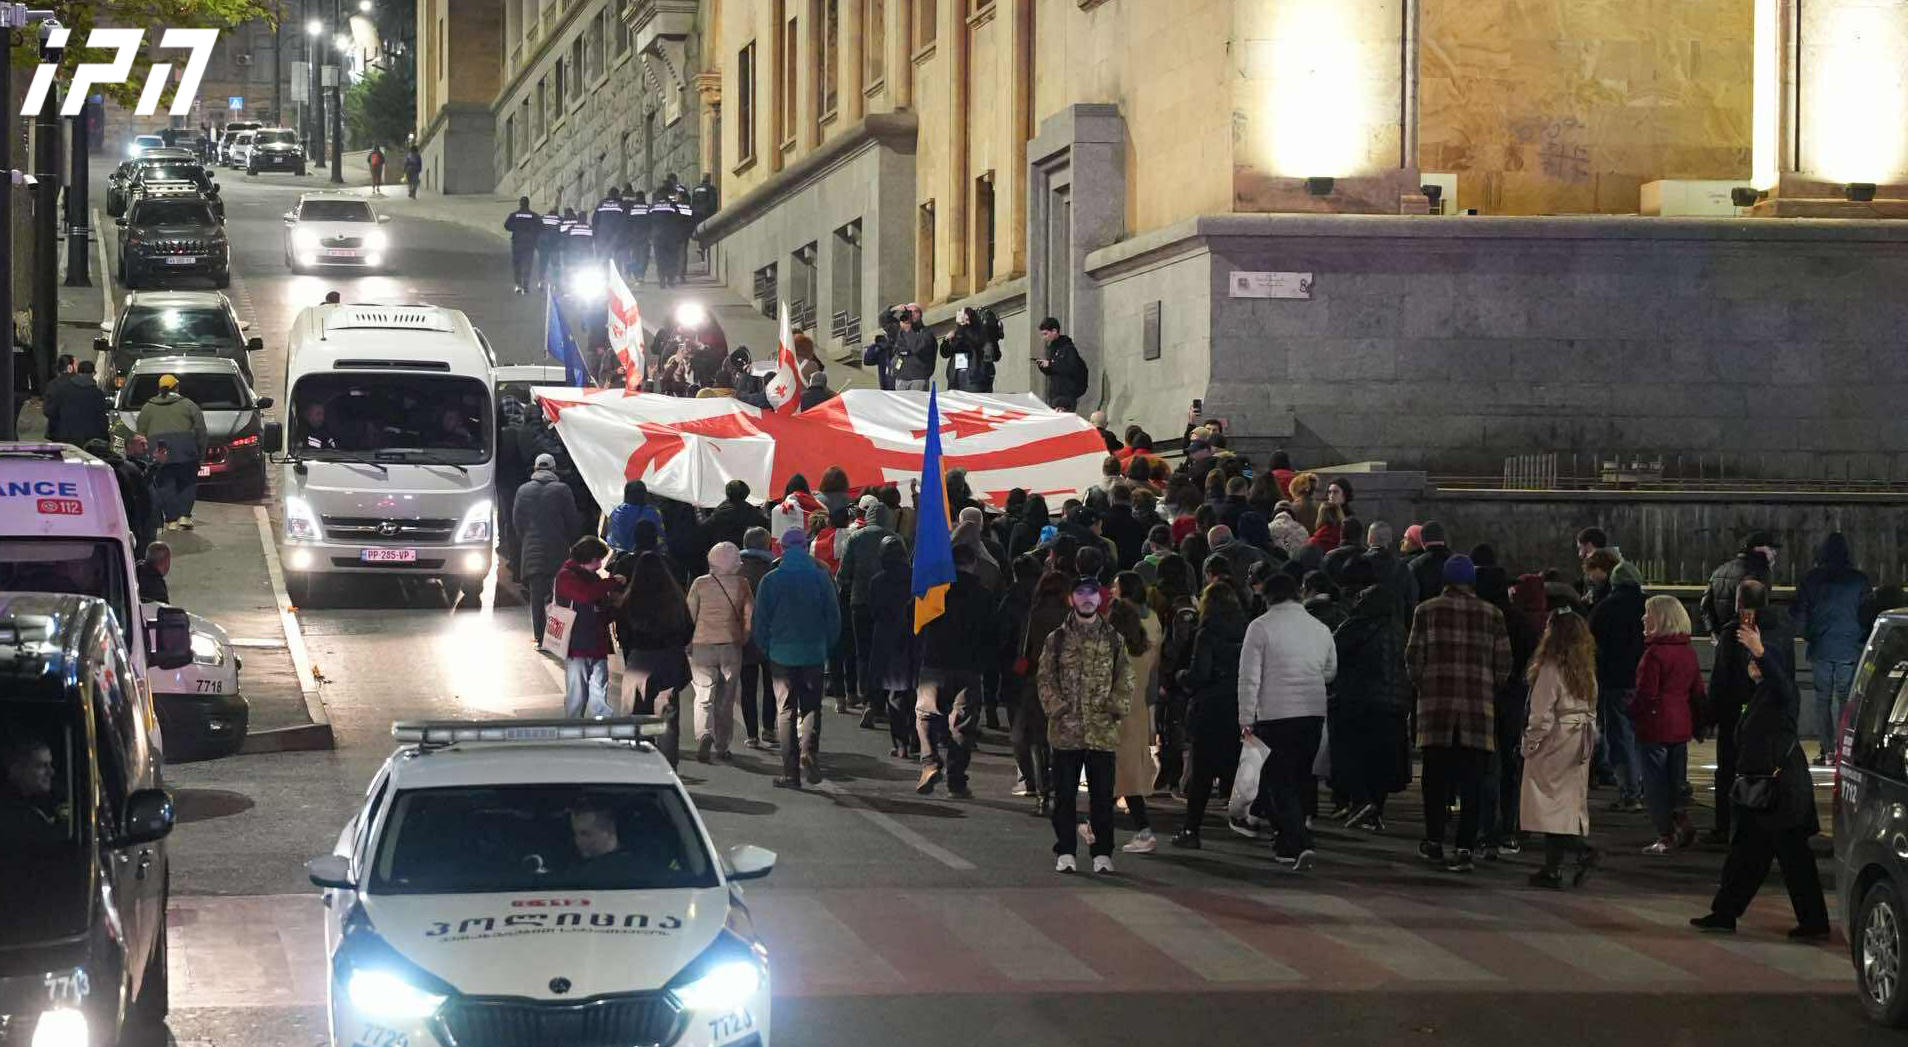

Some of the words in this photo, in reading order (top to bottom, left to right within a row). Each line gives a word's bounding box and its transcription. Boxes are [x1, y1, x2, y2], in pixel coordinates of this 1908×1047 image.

[60, 501, 79, 513] 112
[196, 679, 223, 693] 7718
[425, 912, 682, 936] პოლიცია
